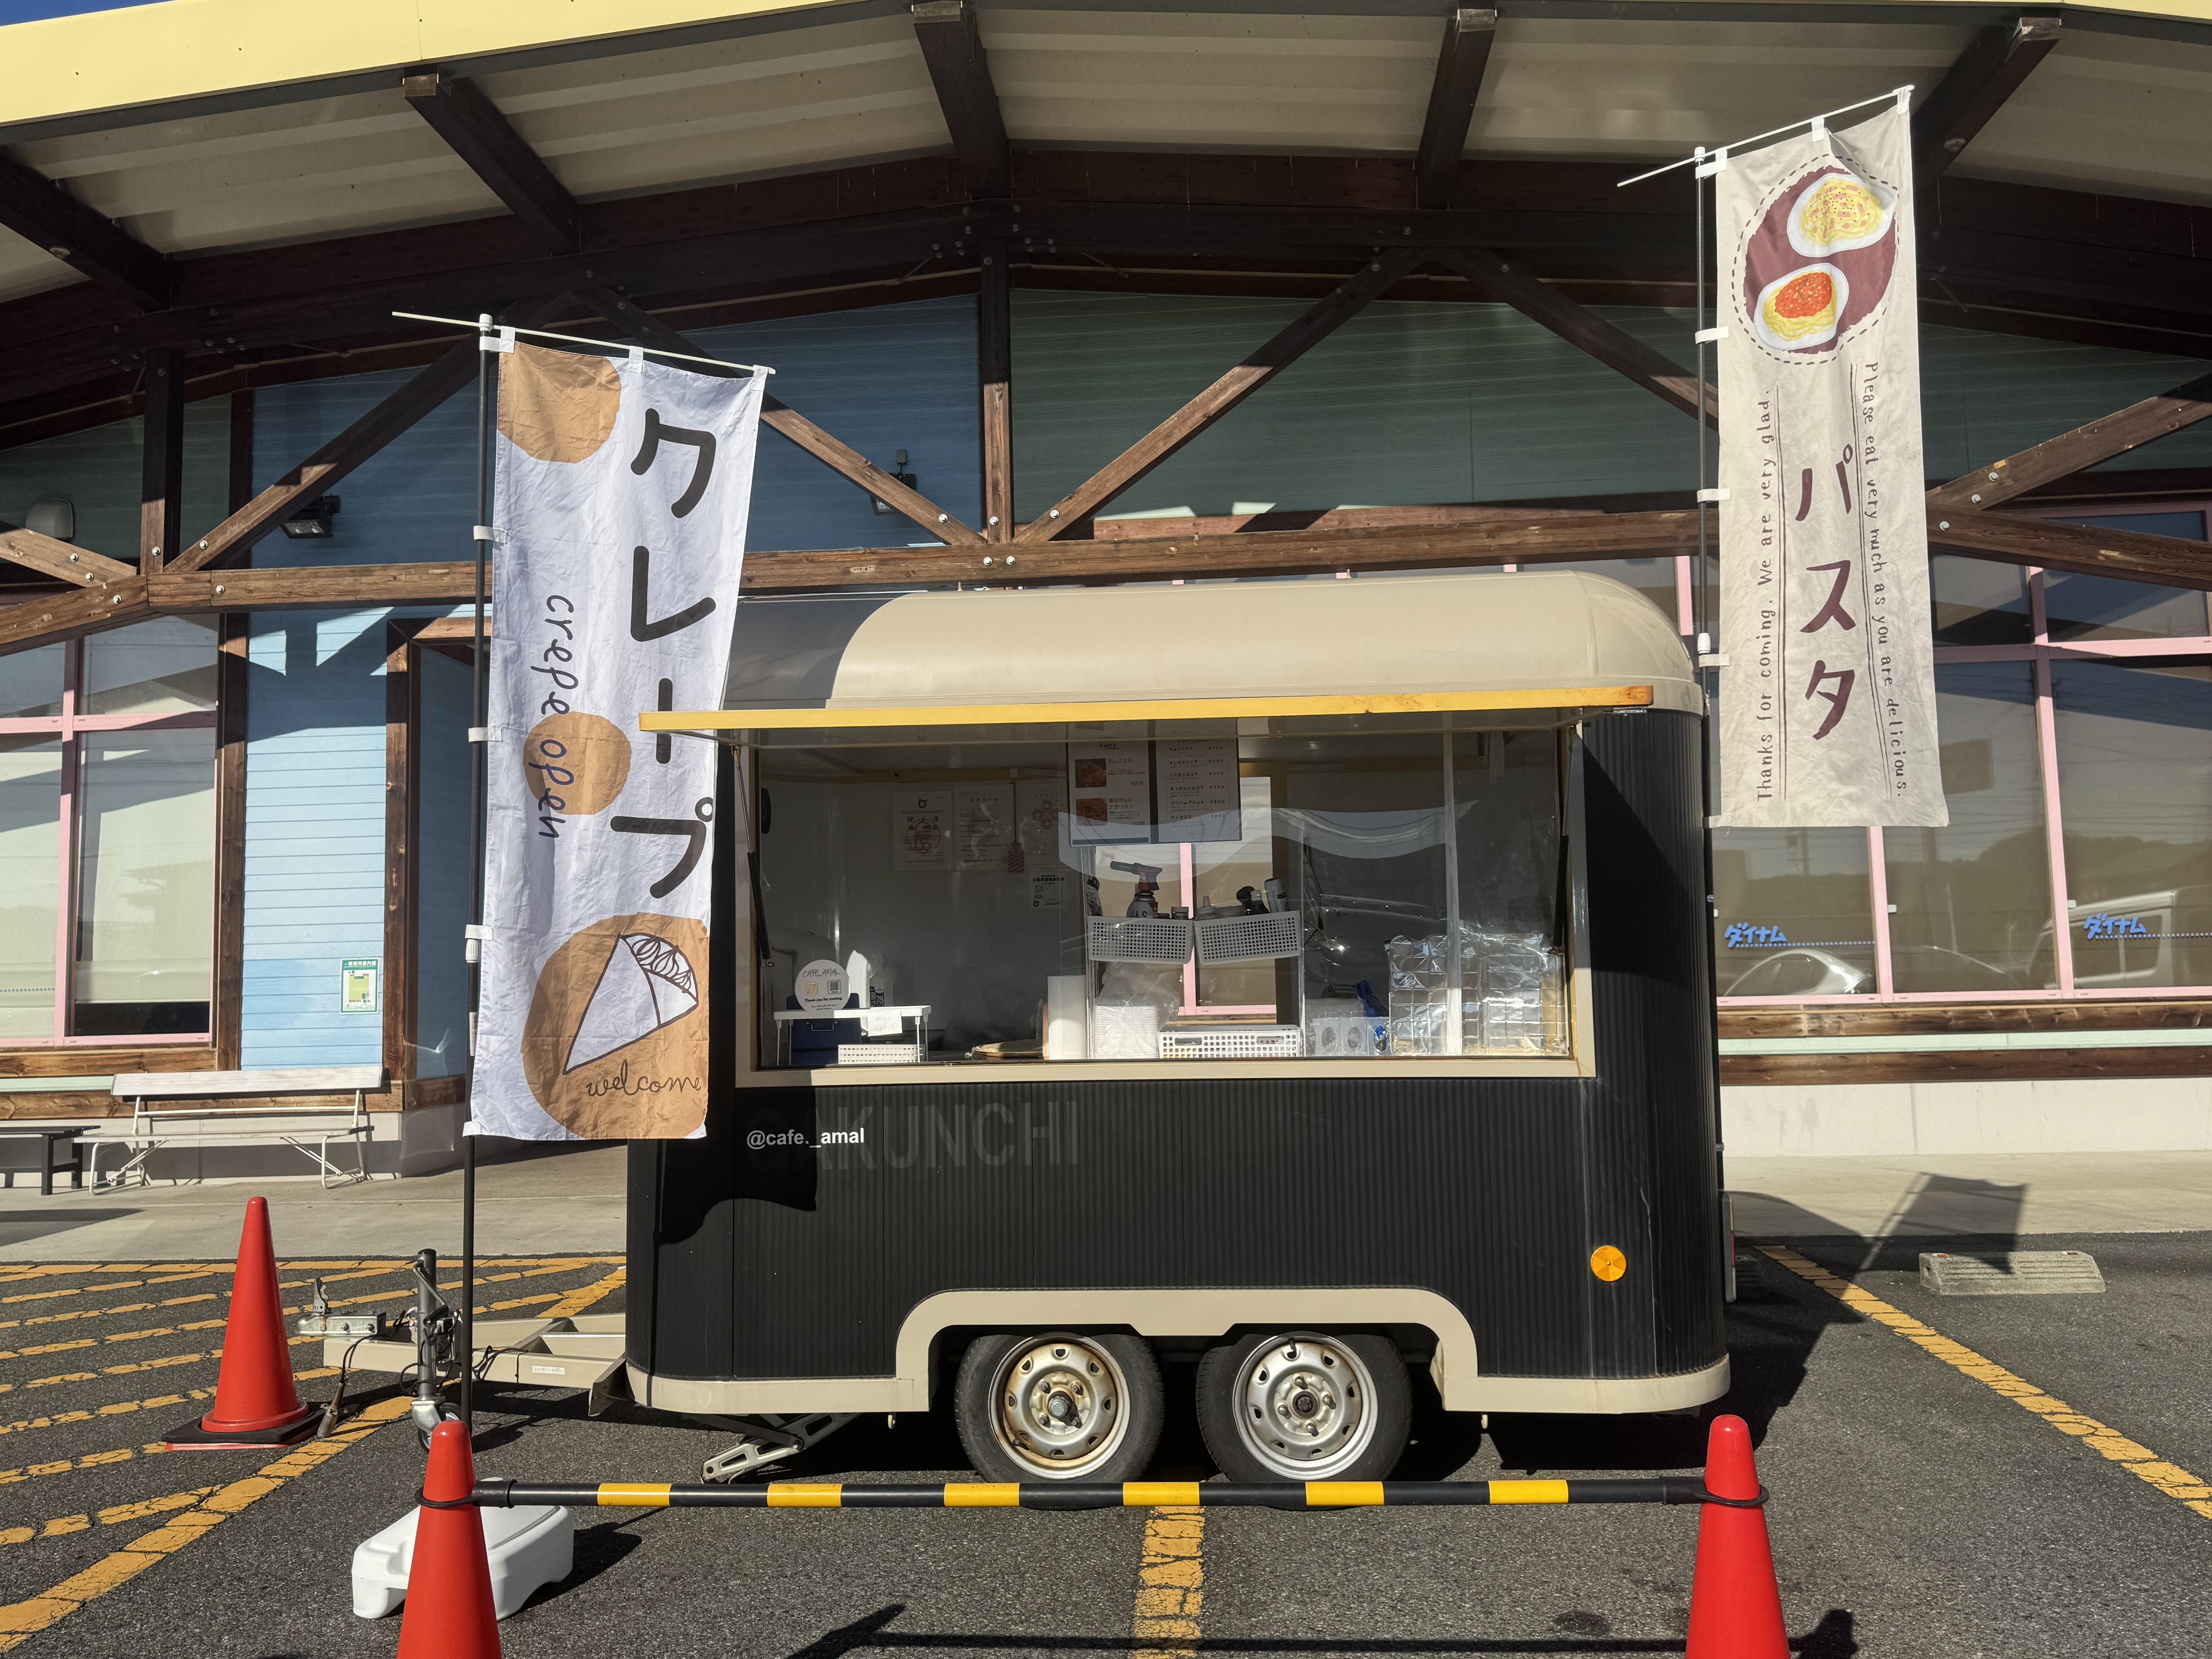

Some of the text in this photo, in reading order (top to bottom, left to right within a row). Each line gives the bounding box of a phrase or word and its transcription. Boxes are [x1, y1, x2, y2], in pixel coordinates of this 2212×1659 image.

[611, 408, 716, 899] クレープ
[1756, 390, 1776, 802] Thanks for coming. We are very glad.
[1795, 444, 1856, 740] パスタ
[1862, 362, 1906, 797] Please eat very much as you are delicious.
[527, 595, 579, 839] crepe open
[876, 996, 884, 1004] 78
[1724, 922, 1787, 948] ダイナム
[2084, 913, 2147, 939] ダイナム
[586, 1059, 701, 1096] welcome
